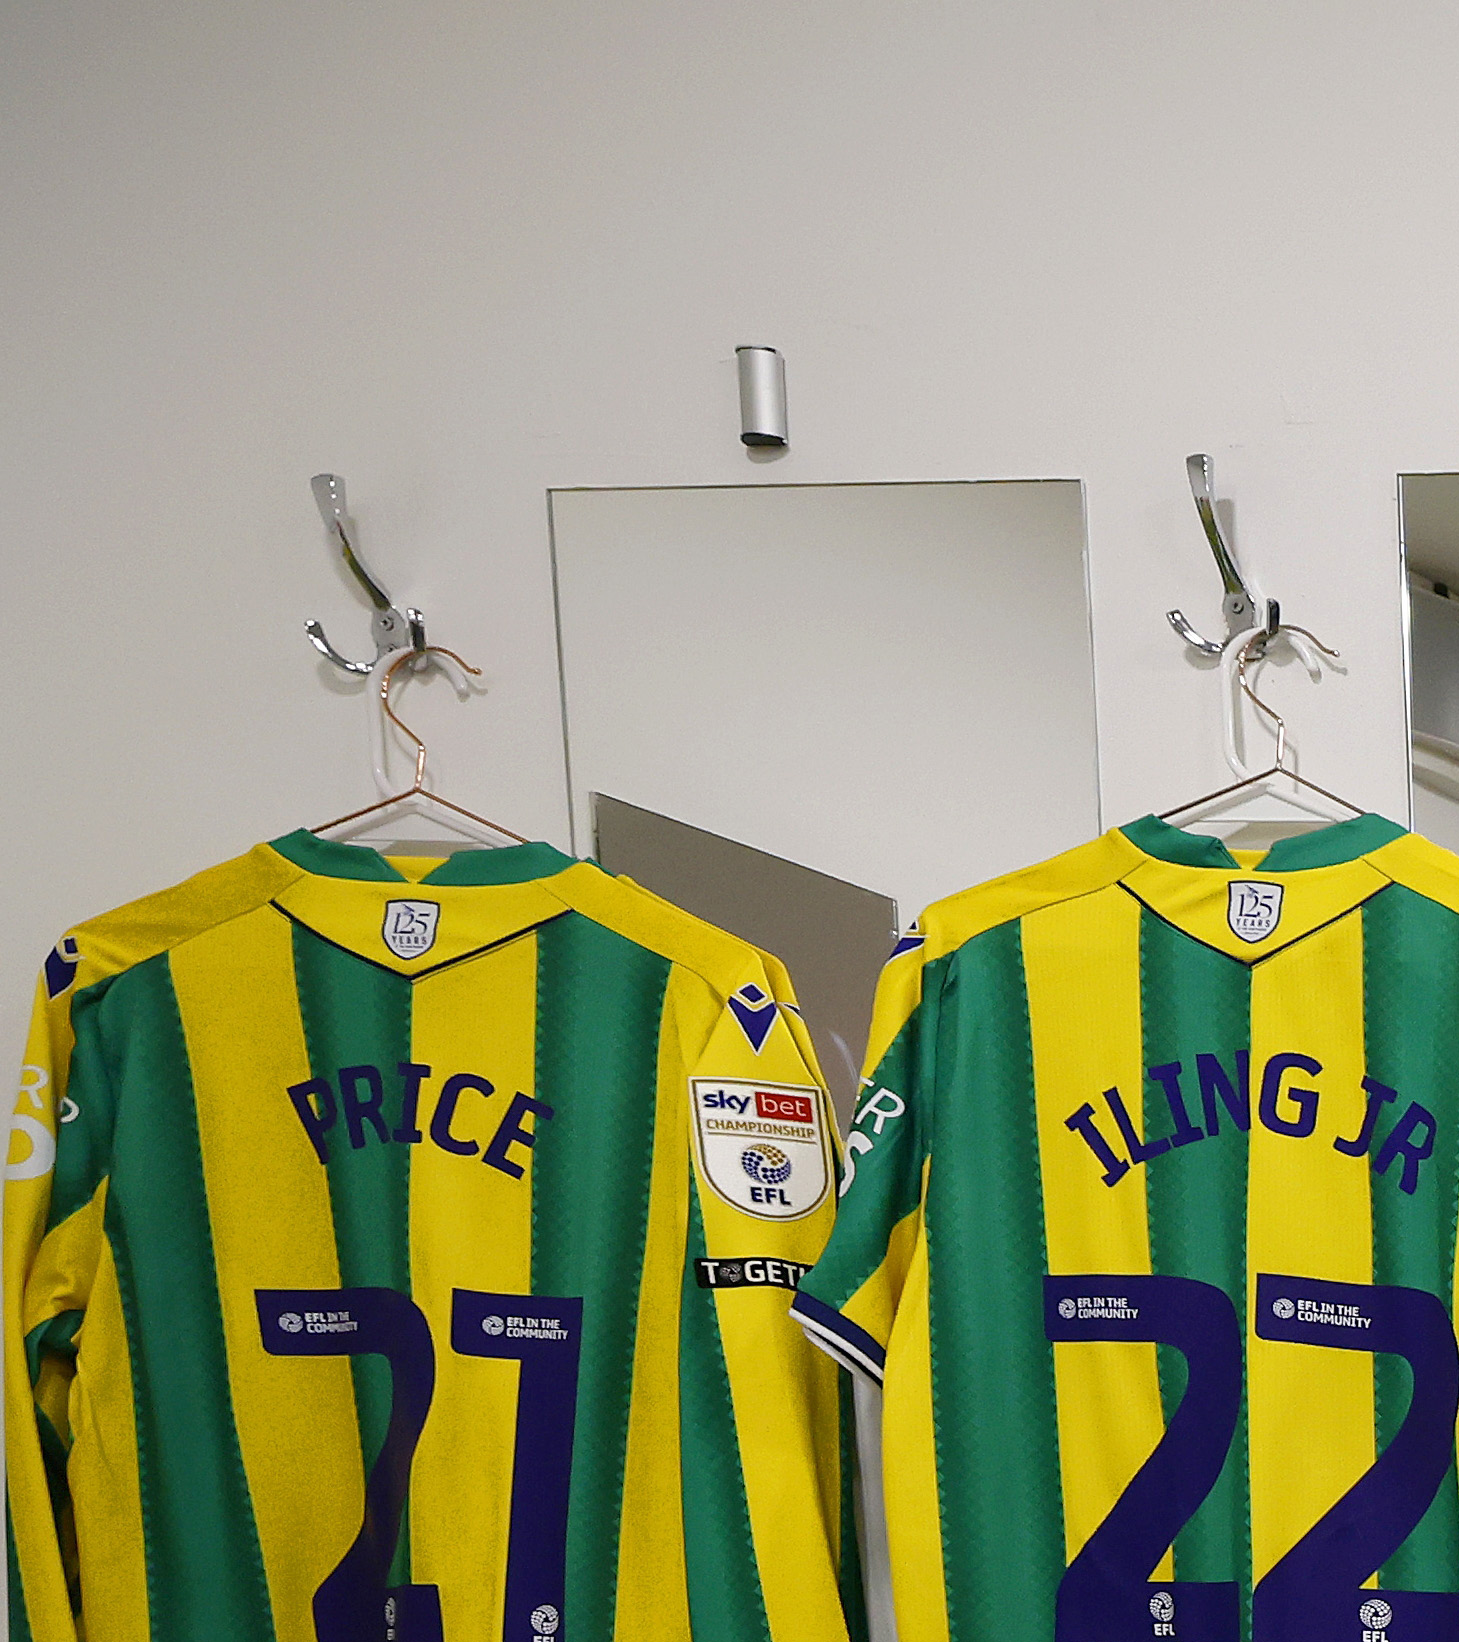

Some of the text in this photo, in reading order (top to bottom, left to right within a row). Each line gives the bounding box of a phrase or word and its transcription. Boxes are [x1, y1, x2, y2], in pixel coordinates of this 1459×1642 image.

[1237, 893, 1274, 919] 125
[393, 912, 430, 935] 125
[1236, 918, 1271, 928] YEARS
[391, 935, 427, 946] YEARS
[704, 1090, 807, 1118] sky bet
[286, 1063, 556, 1180] PRICE
[706, 1119, 816, 1139] CHAMPIONSHIP
[1065, 1048, 1439, 1194] ILING JR
[751, 1186, 791, 1206] EFL
[1077, 1297, 1128, 1308] EFL IN THE
[1297, 1299, 1360, 1316] EFL IN THE
[304, 1312, 327, 1323] EFL
[1078, 1308, 1138, 1319] COMMUNITY
[1297, 1310, 1371, 1328] COMMUNITY
[506, 1316, 560, 1329] EFL IN THE
[506, 1327, 568, 1340] COMMUNITY
[1153, 1623, 1175, 1636] EFL
